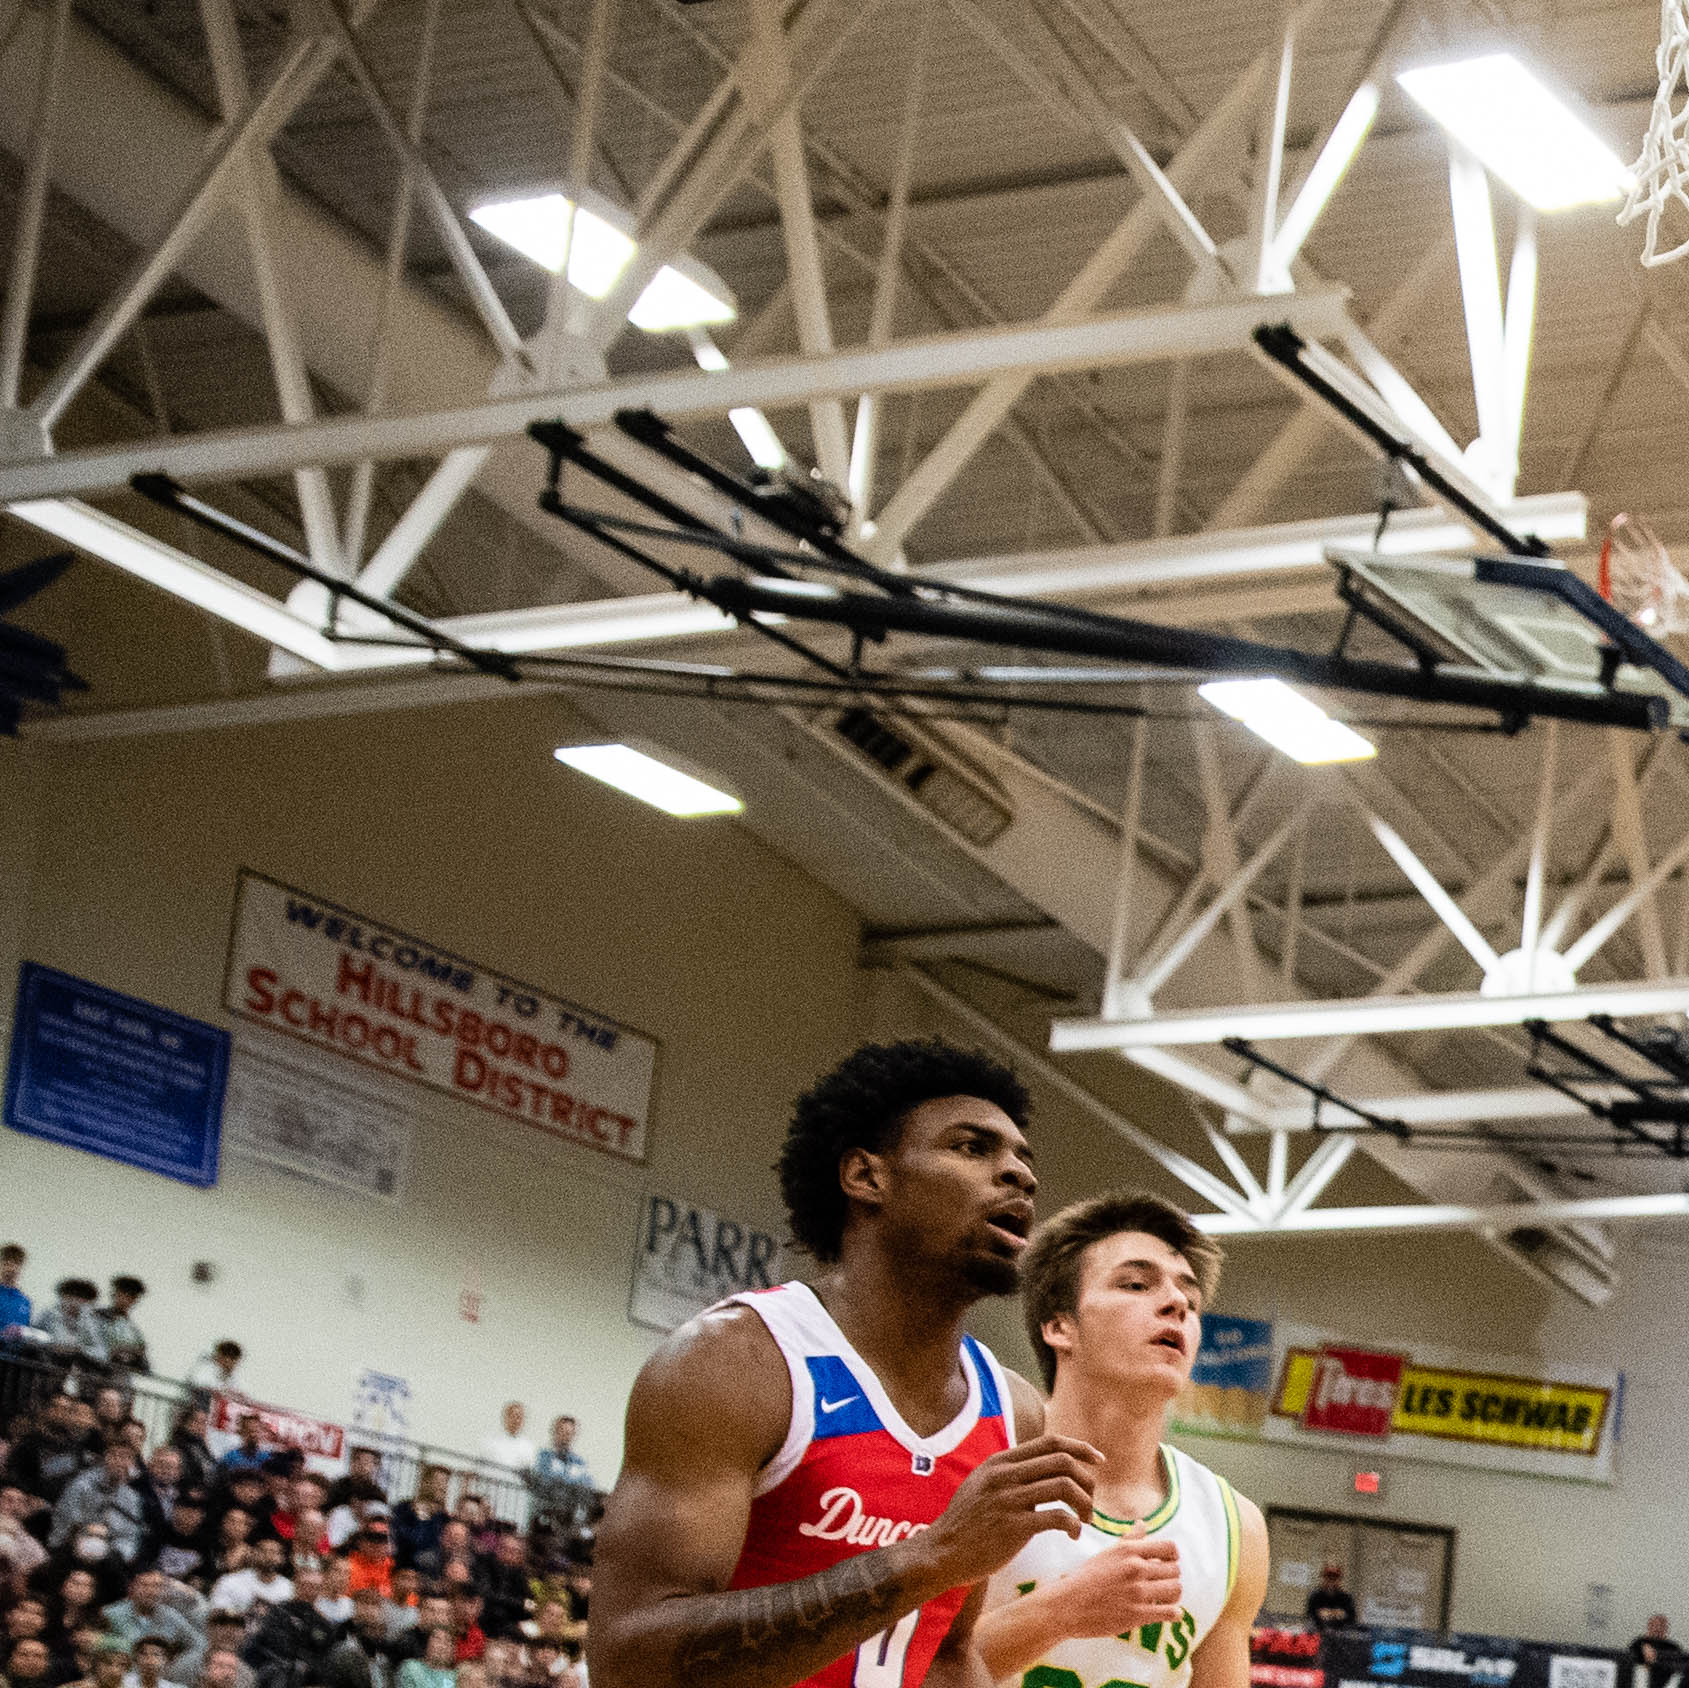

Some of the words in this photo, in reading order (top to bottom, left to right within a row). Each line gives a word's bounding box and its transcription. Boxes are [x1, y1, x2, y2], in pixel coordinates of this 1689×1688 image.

[285, 899, 474, 993] WELCOME
[496, 983, 541, 1018] TO
[557, 1010, 621, 1052] THE
[336, 951, 570, 1081] HILLSBORO
[246, 966, 425, 1072] SCHOOL
[453, 1045, 637, 1146] DISTRICT
[1404, 1384, 1453, 1419] LES
